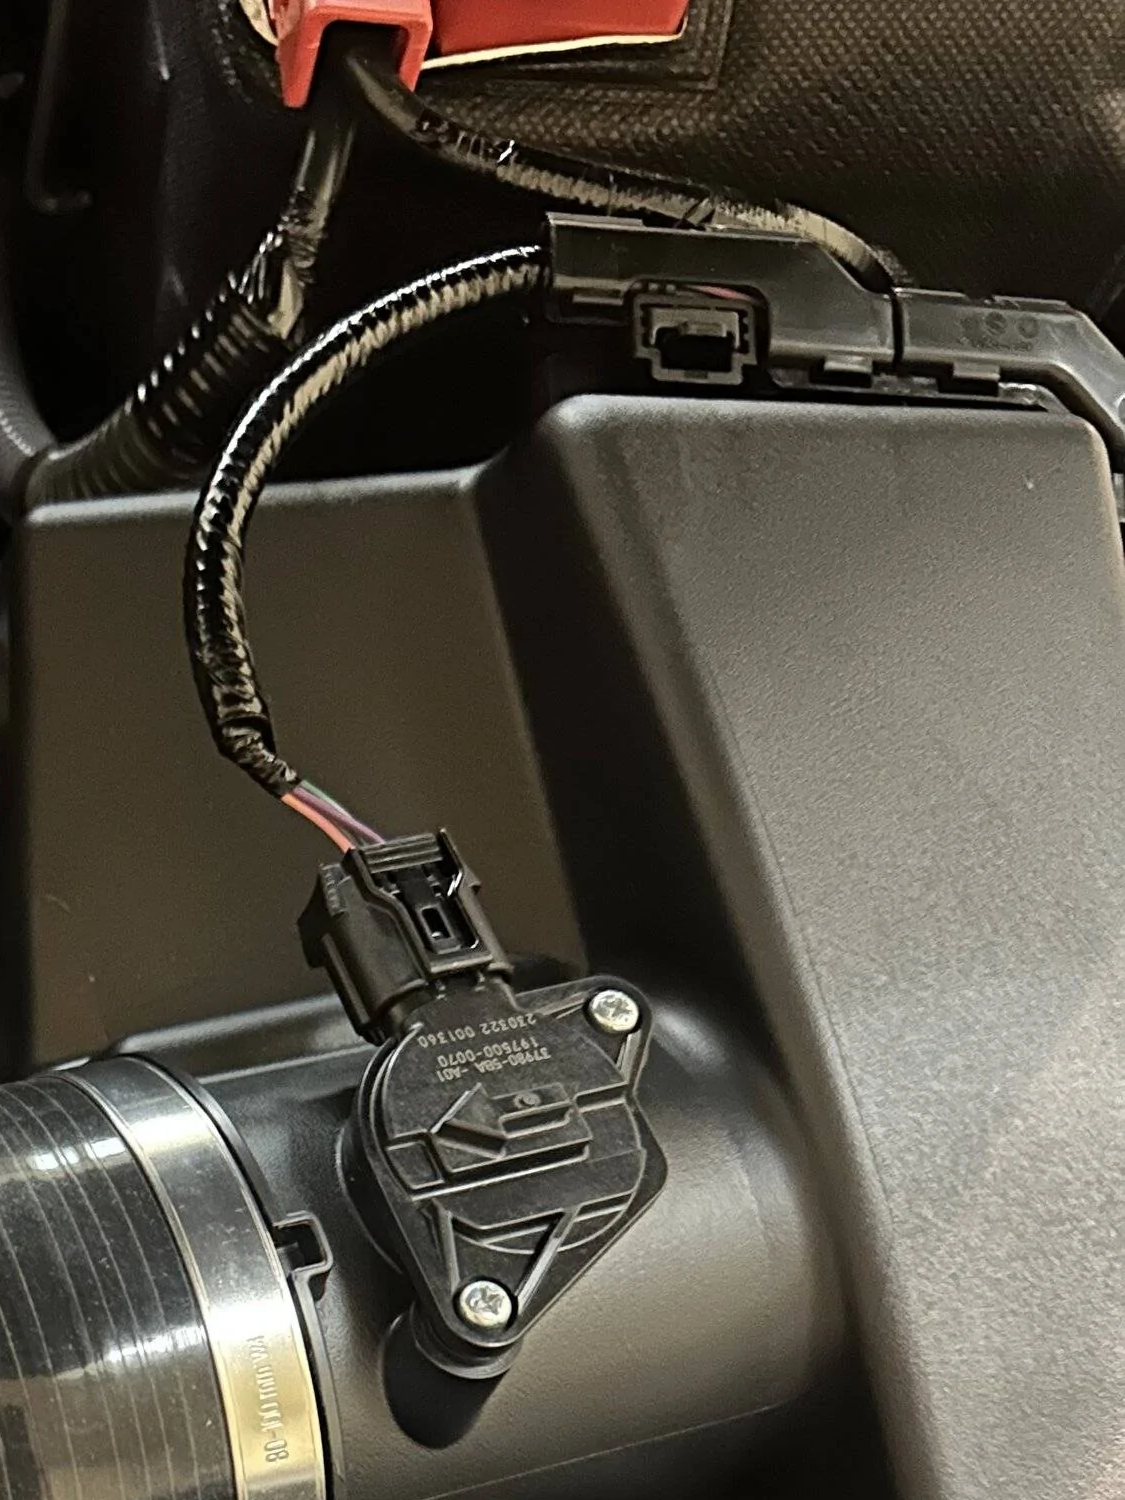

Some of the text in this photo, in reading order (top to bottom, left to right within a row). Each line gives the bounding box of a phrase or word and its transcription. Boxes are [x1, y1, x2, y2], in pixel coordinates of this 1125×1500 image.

[417, 1013, 536, 1048] 230322 001360
[437, 1036, 539, 1068] 197500-0070
